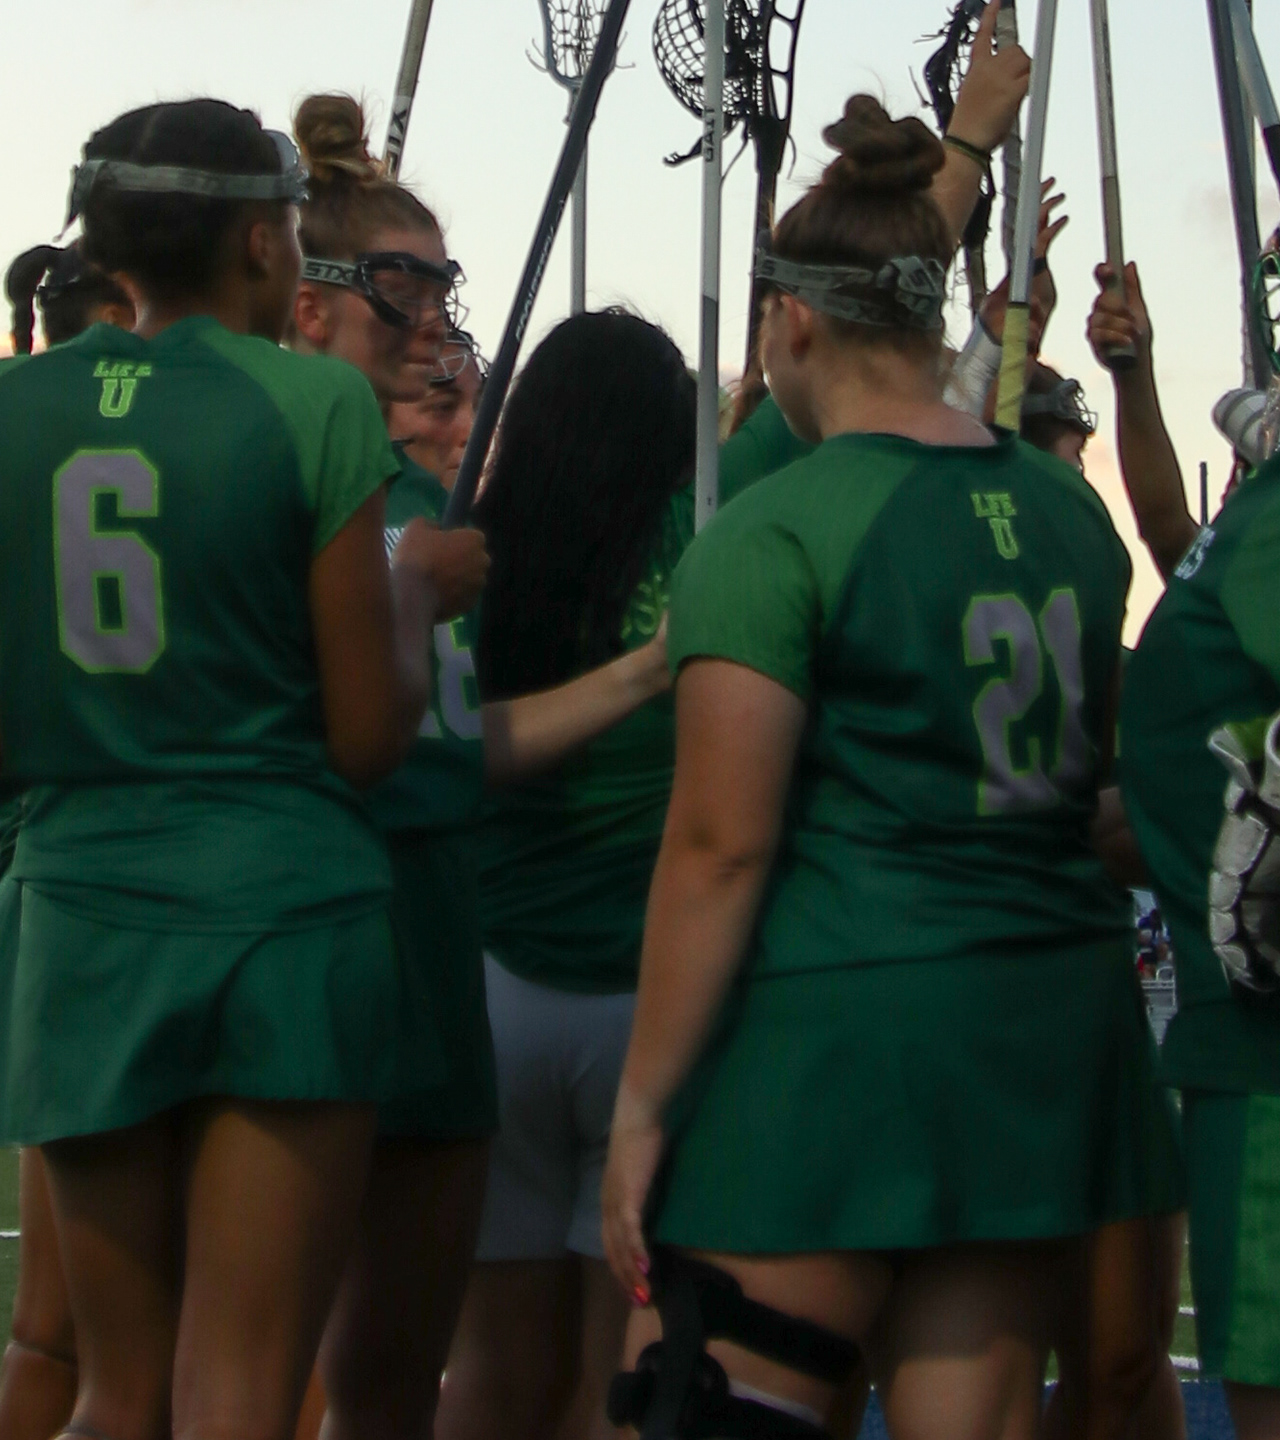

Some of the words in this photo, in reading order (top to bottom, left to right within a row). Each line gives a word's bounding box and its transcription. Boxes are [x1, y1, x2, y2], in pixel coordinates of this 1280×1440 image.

[303, 261, 357, 283] STX
[98, 378, 139, 419] U
[987, 518, 1020, 560] U
[51, 447, 167, 675] 6
[961, 586, 1098, 818] 21
